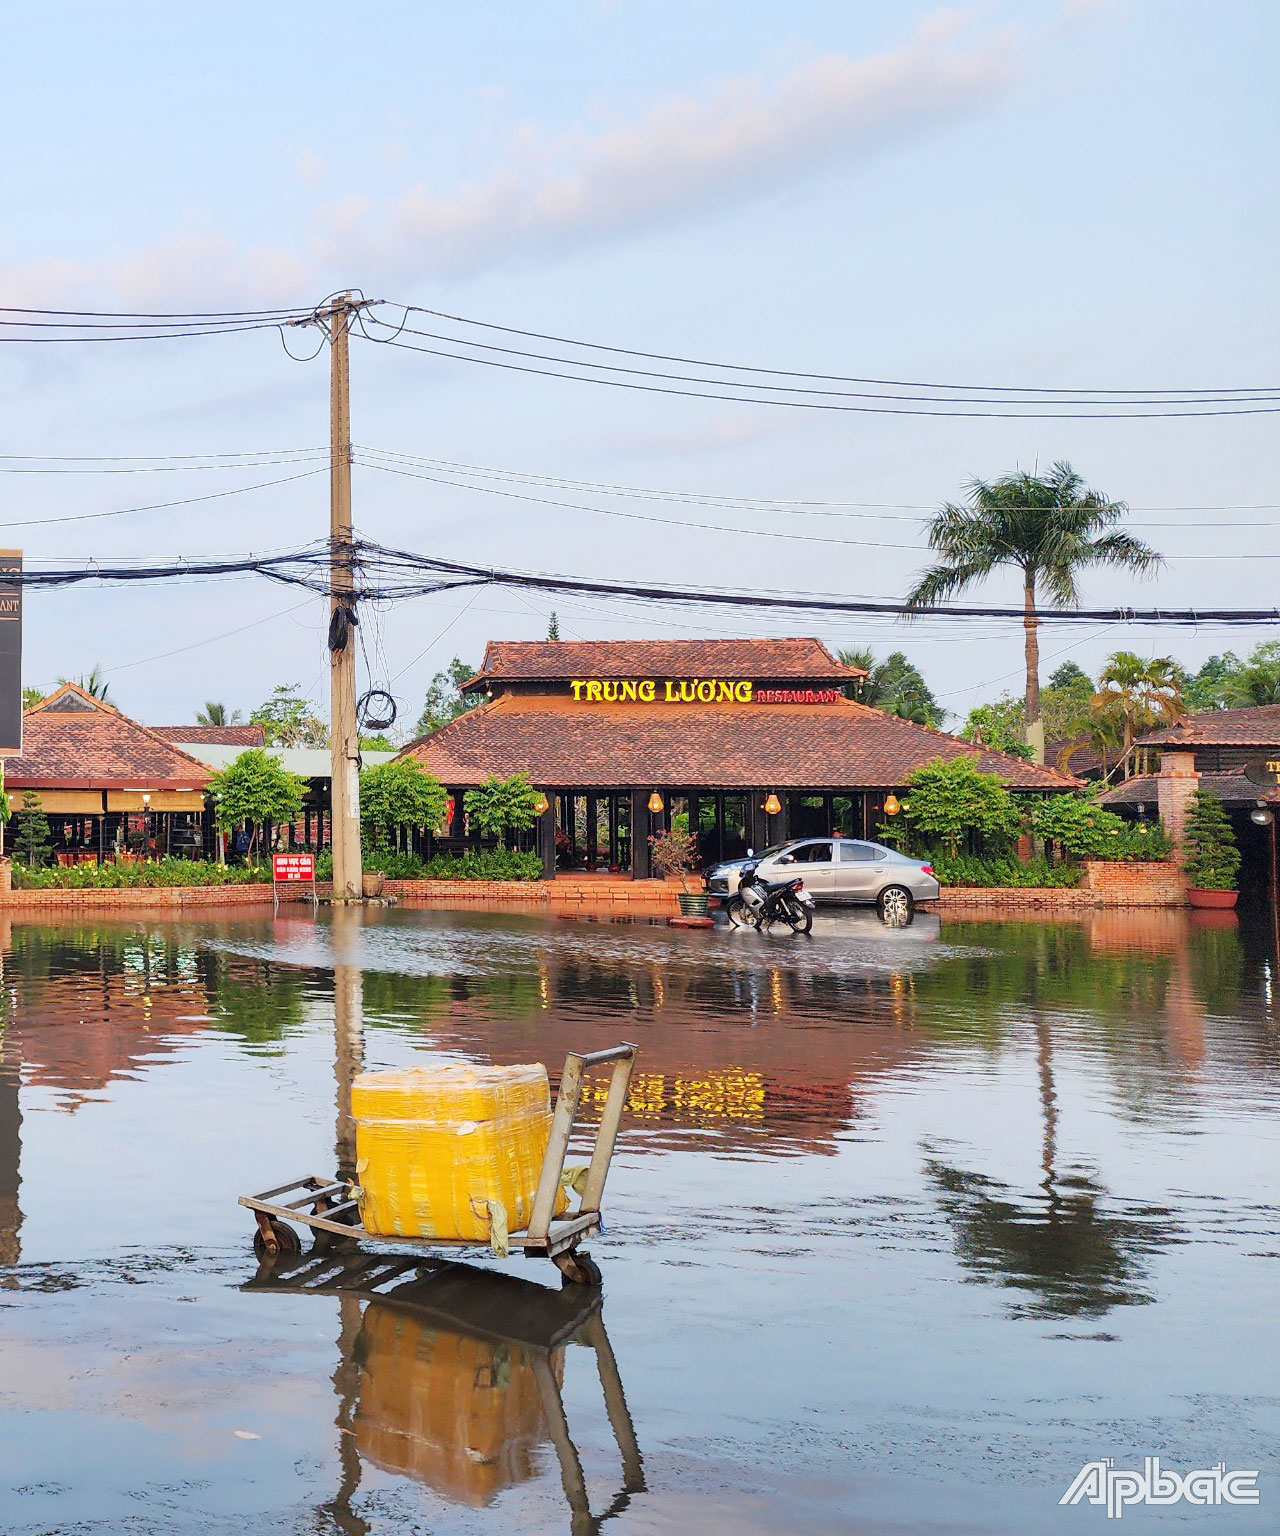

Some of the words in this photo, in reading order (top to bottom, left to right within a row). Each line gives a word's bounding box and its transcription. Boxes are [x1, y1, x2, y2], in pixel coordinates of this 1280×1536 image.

[570, 680, 656, 702] TRUNG
[664, 678, 753, 703] LƯƠNG
[756, 690, 841, 703] RESTAURANT
